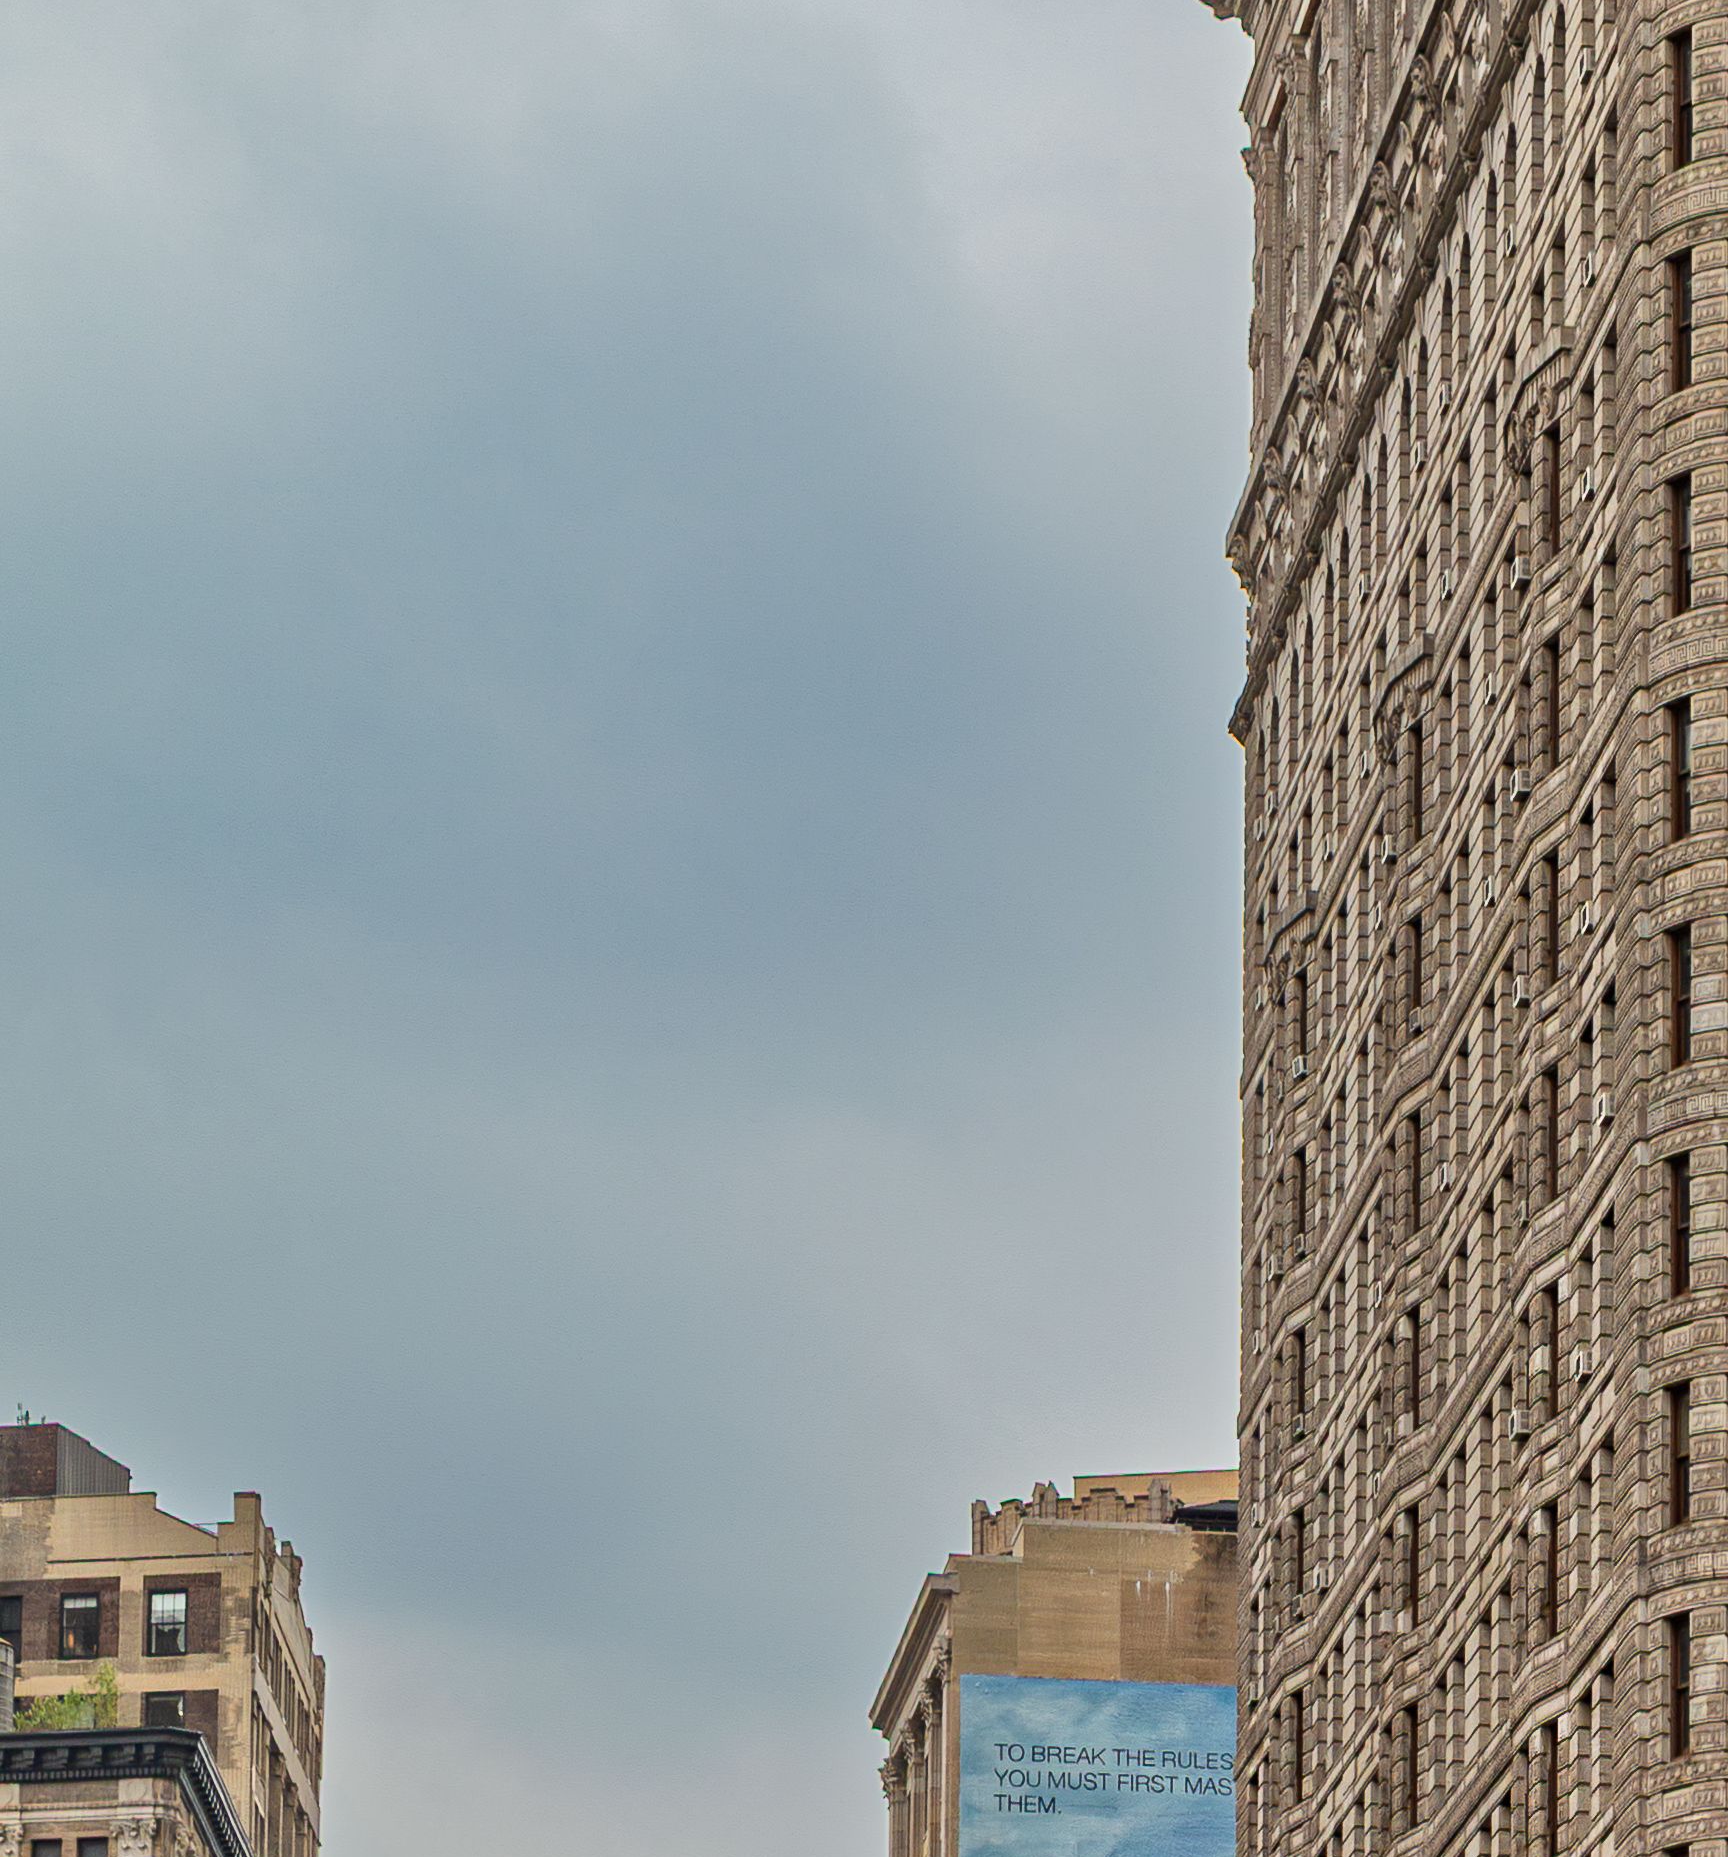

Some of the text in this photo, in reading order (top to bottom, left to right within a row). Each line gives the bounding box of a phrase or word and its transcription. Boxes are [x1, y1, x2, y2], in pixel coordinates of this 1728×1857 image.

[994, 1743, 1234, 1770] TO BREAK THE RULES
[994, 1769, 1041, 1788] YOU
[1047, 1771, 1110, 1791] MUST
[1117, 1774, 1178, 1794] FIRST
[993, 1794, 1062, 1815] THEM.
